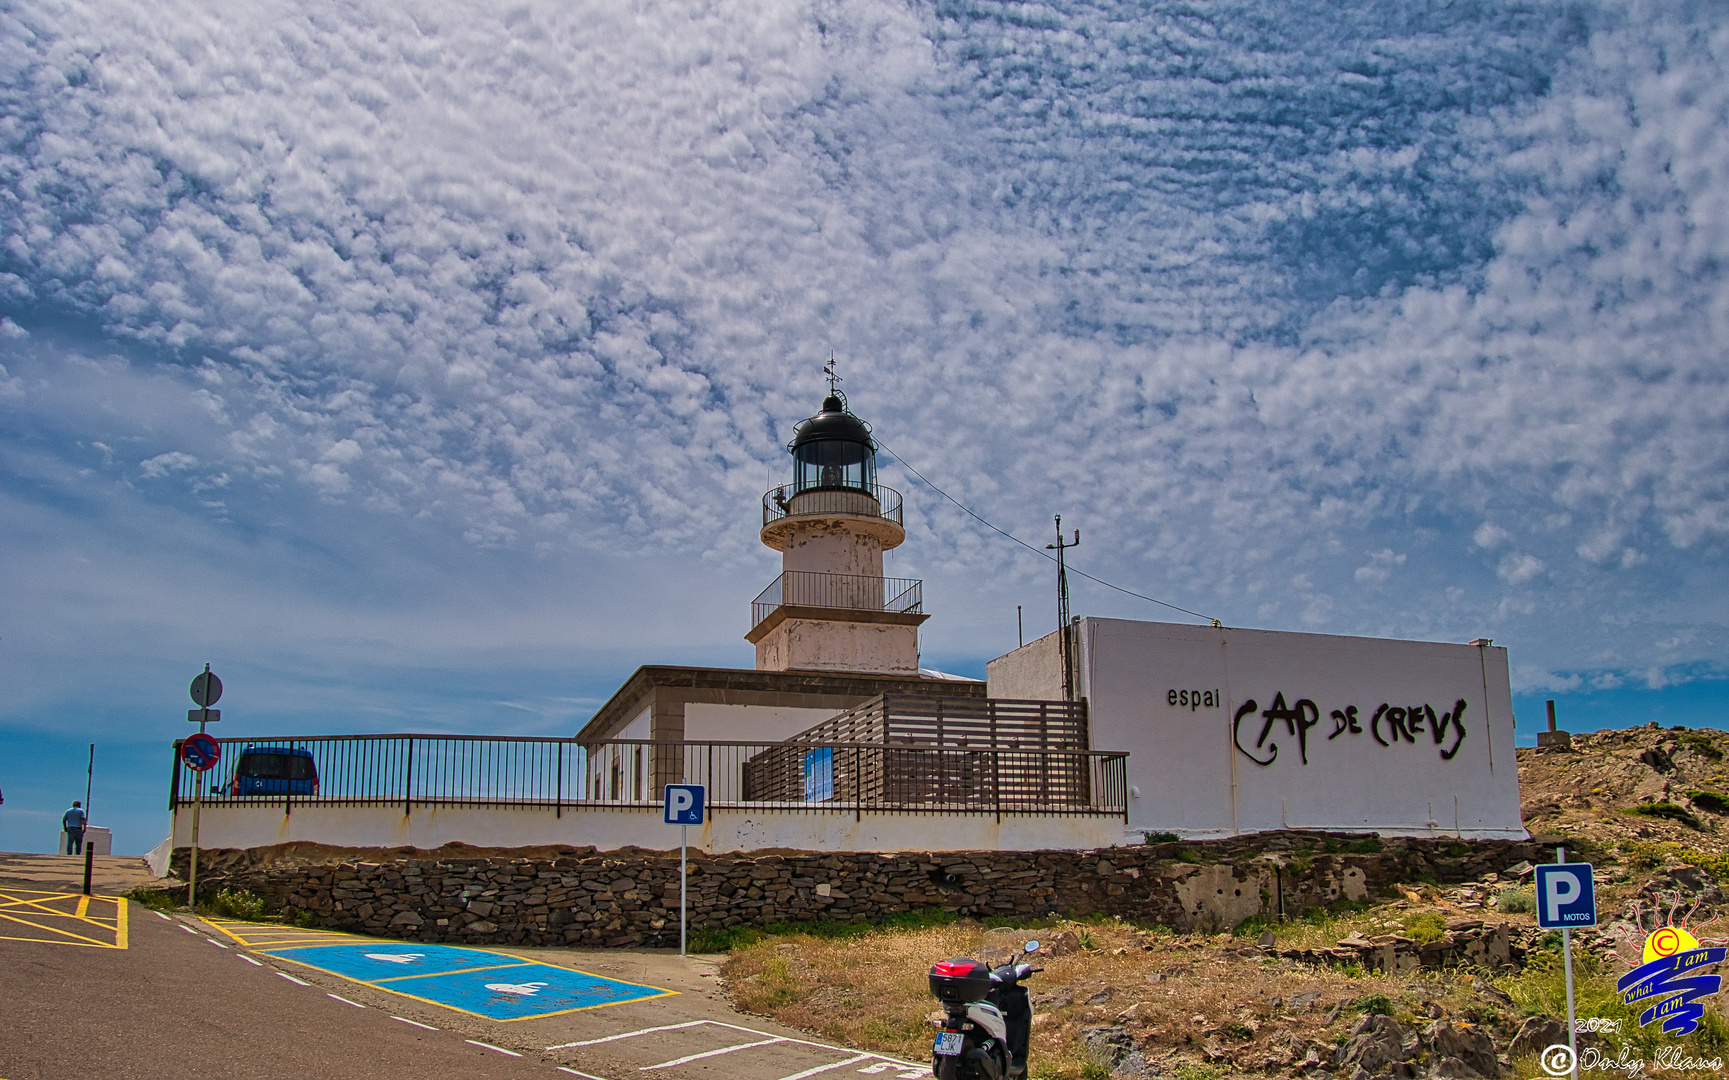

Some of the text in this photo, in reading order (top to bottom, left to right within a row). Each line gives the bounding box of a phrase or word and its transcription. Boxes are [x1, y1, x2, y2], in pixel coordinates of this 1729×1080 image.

[1168, 688, 1221, 712] espai
[1233, 691, 1319, 766] CAP
[1328, 705, 1362, 740] DE
[669, 788, 693, 821] P
[1545, 871, 1581, 921] P
[1563, 912, 1591, 921] MOTOS
[940, 1042, 956, 1052] LJK
[942, 1033, 962, 1044] 5871
